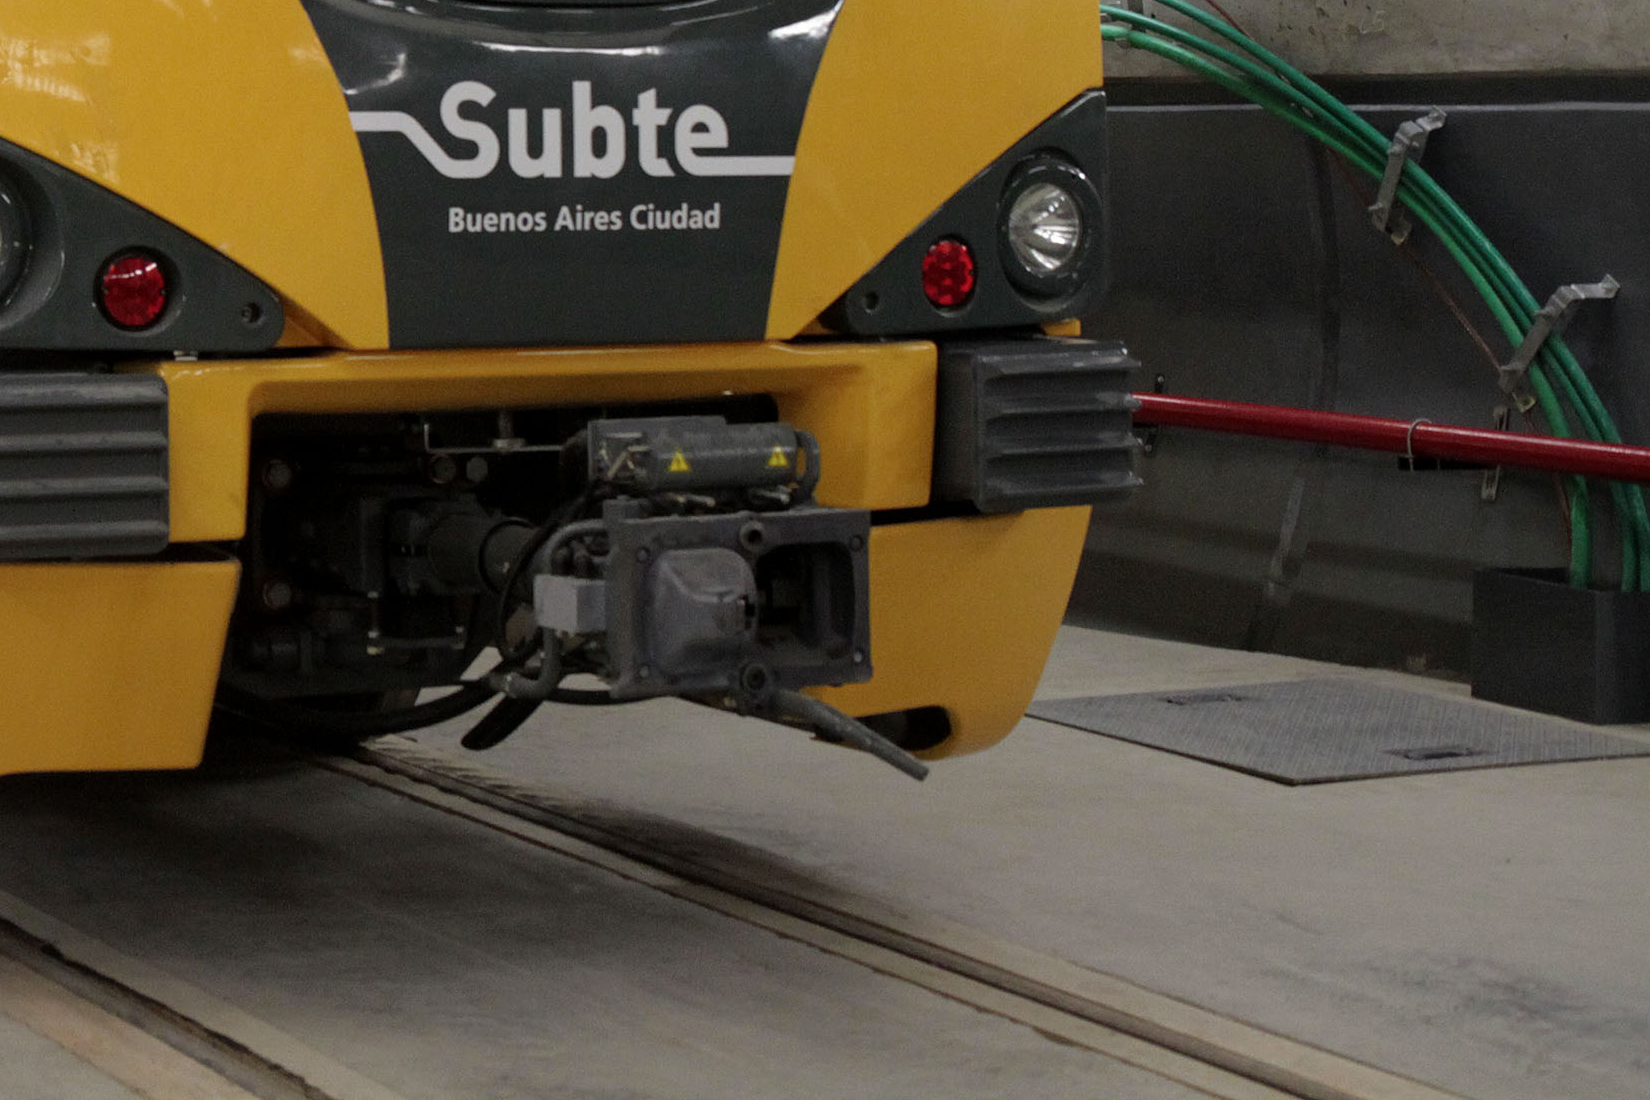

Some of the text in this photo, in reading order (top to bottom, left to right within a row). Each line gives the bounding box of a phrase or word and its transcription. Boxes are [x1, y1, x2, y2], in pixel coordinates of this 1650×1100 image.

[439, 80, 730, 179] Subte
[448, 202, 721, 233] Buenos Aires Ciudad
